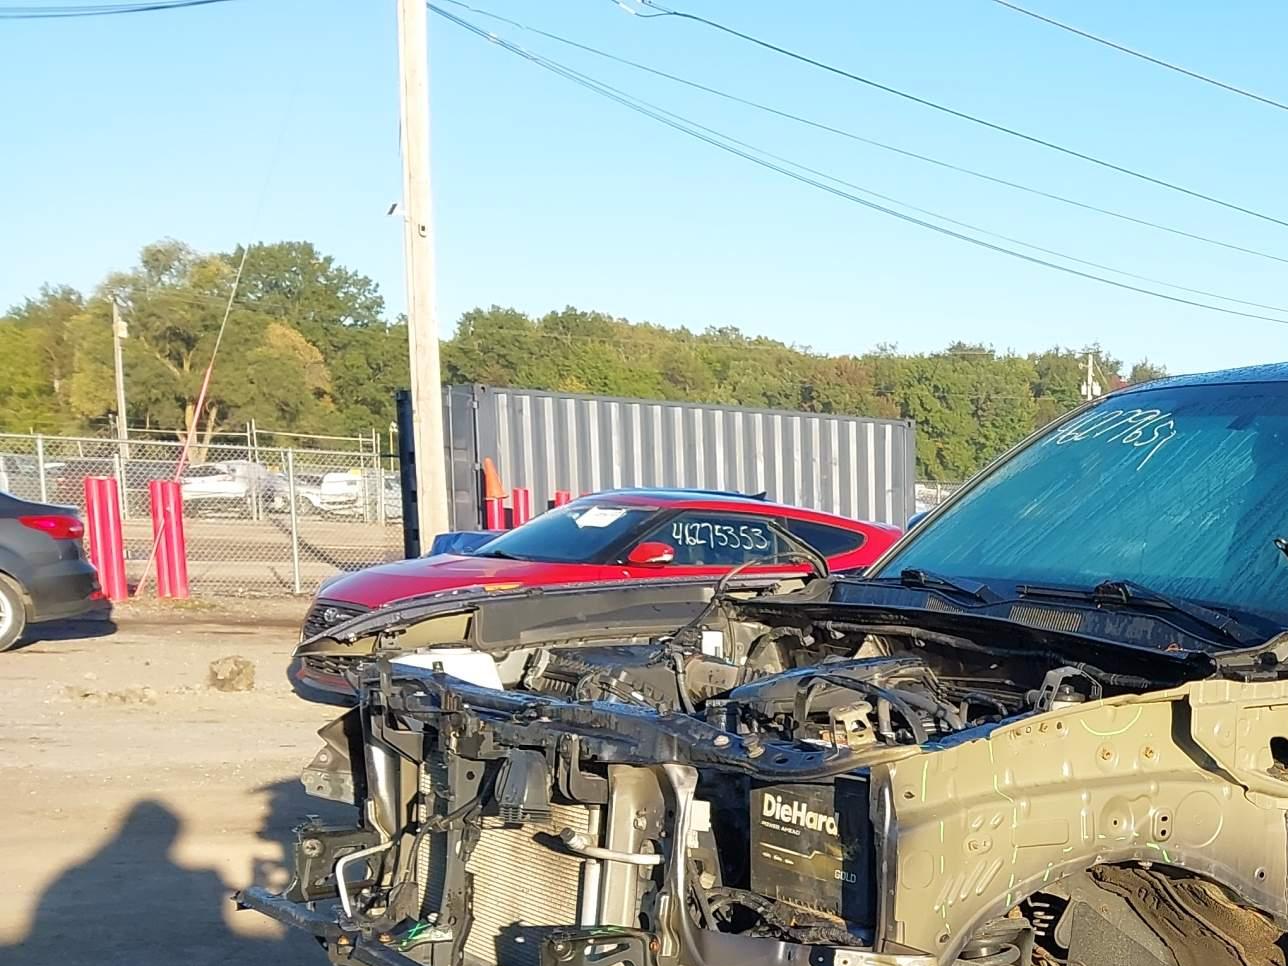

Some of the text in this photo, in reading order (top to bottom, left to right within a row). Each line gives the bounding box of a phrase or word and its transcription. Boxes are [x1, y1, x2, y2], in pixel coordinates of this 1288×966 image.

[1041, 408, 1177, 472] 46279651
[671, 522, 768, 549] 46275353
[762, 792, 840, 837] DieHard
[834, 869, 857, 884] GOLD
